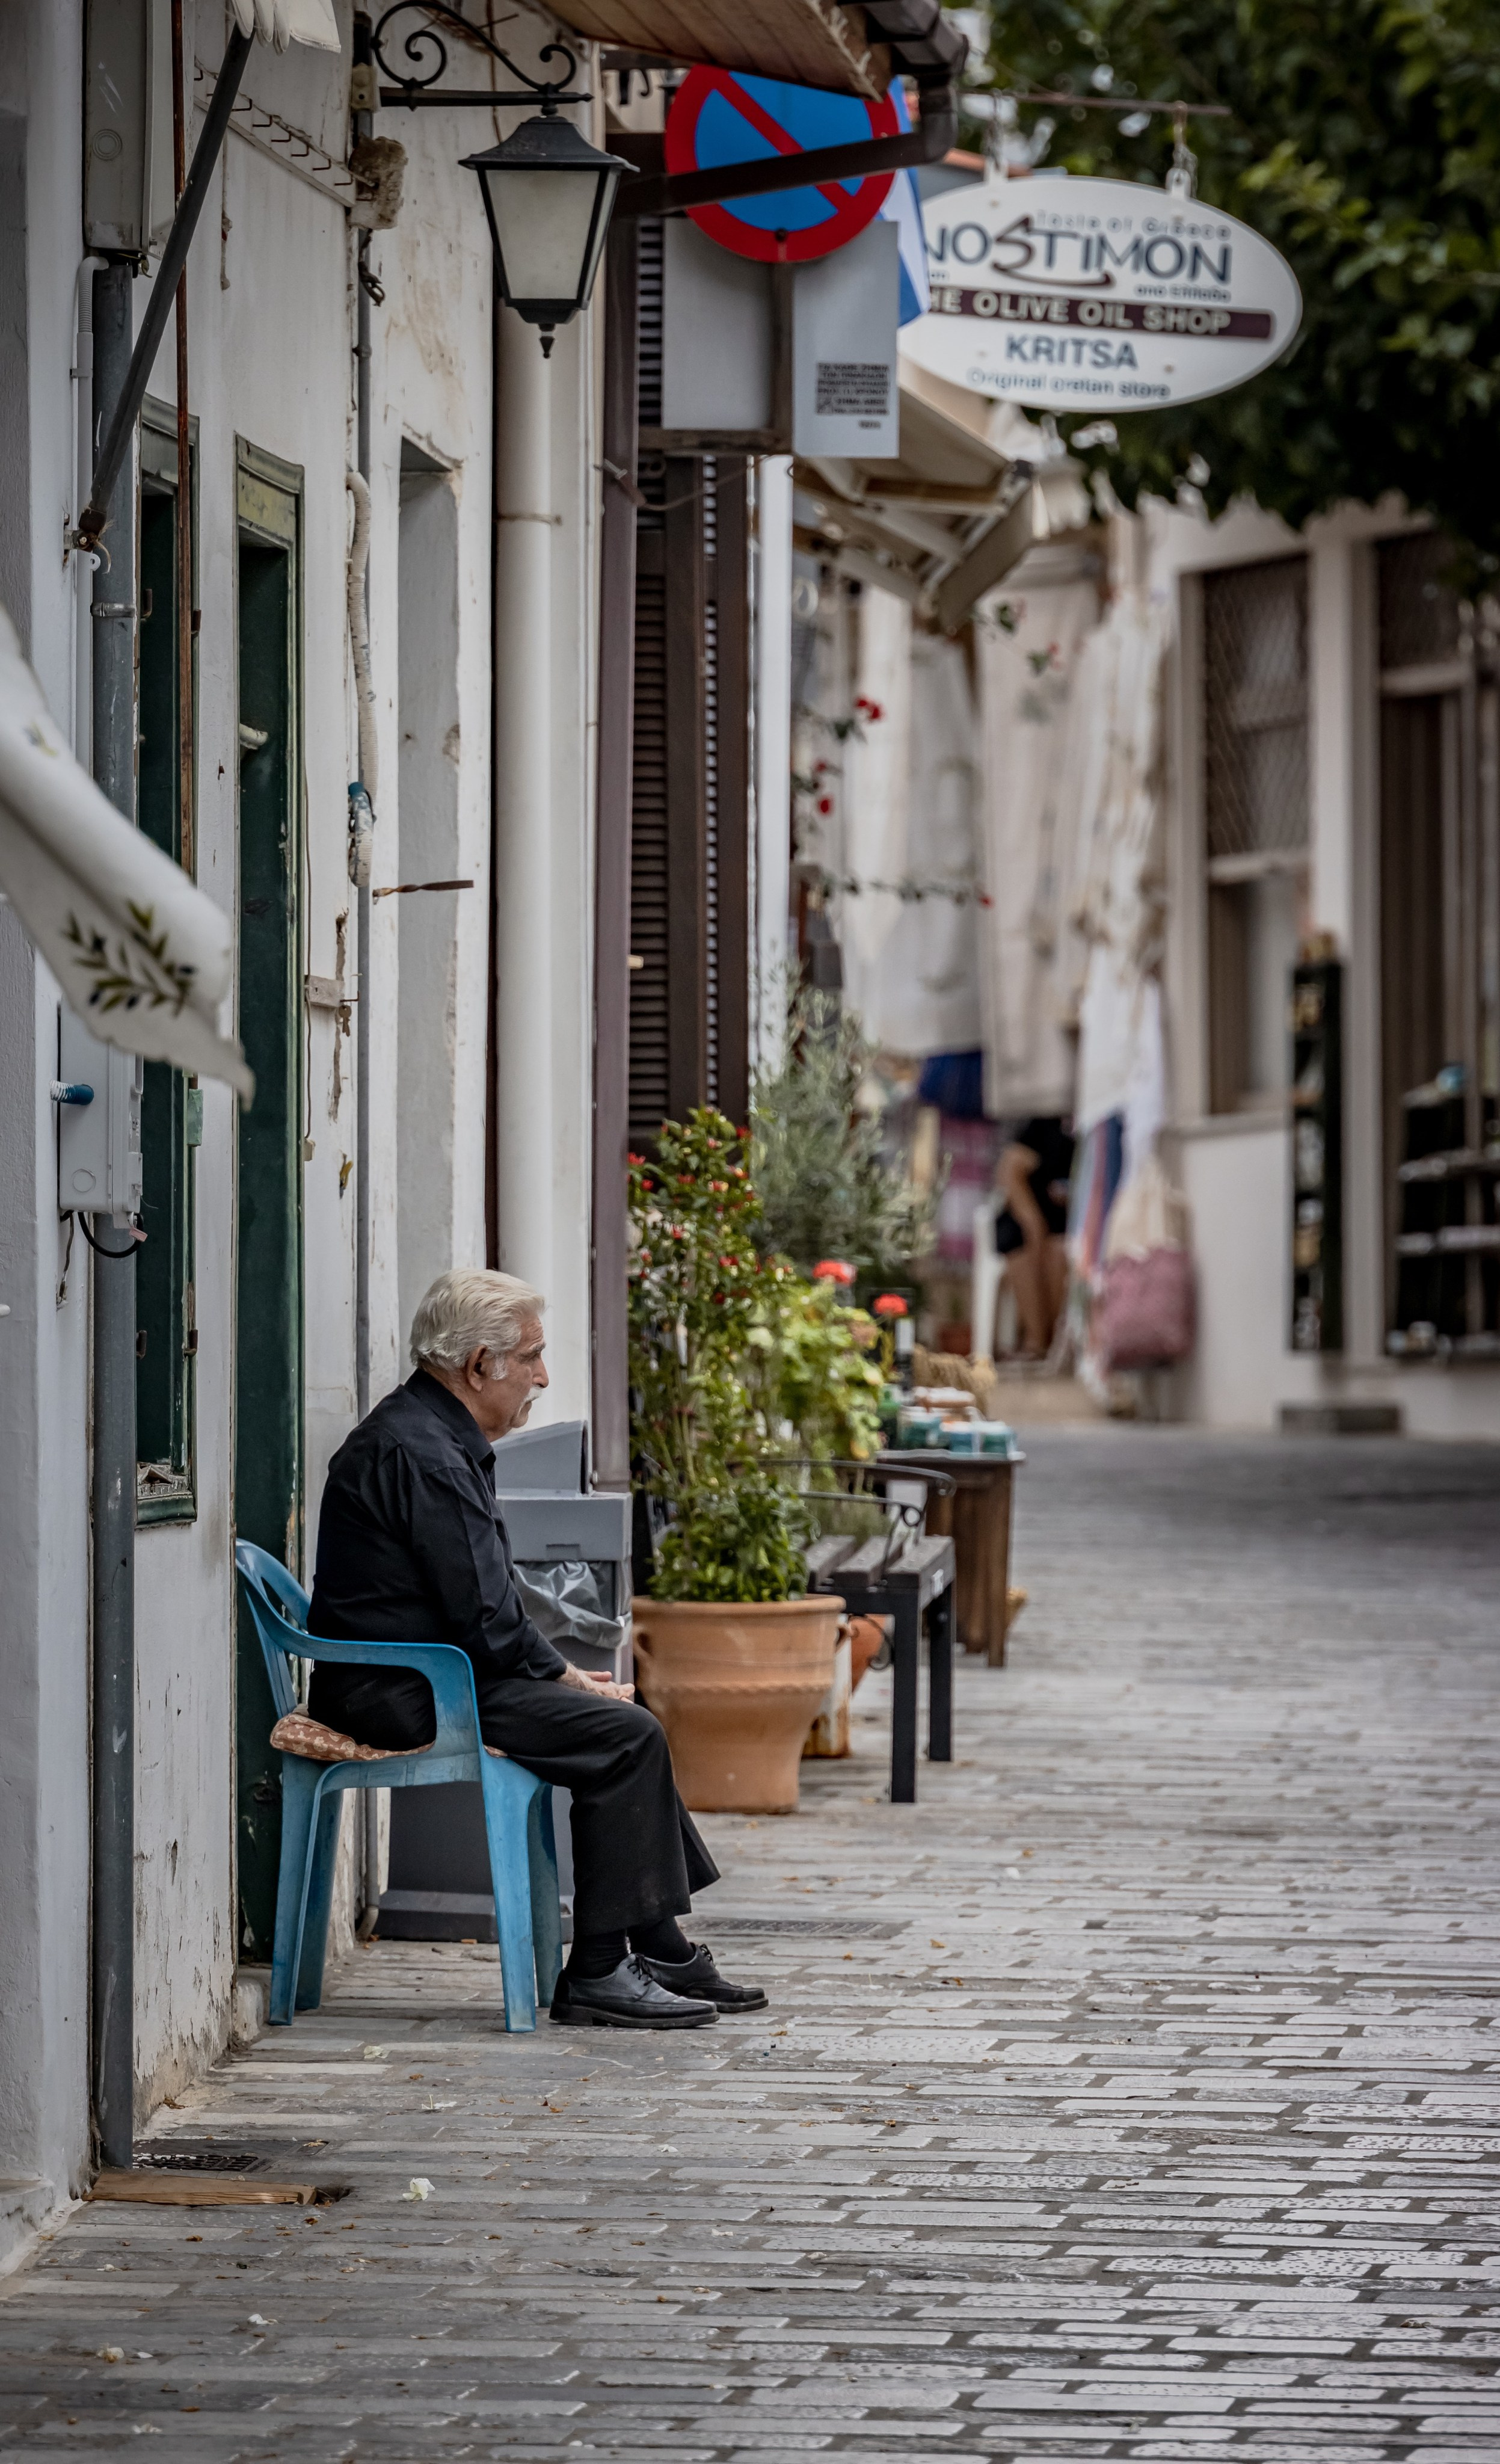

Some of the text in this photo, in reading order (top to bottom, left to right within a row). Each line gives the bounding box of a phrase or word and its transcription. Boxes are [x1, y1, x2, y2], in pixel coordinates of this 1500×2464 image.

[972, 289, 1069, 324] OLIVE
[1077, 300, 1134, 329] OIL
[1143, 304, 1231, 335] SHOP
[1006, 334, 1139, 371] KRITSA
[966, 367, 1047, 392] Original
[1118, 380, 1171, 399] store
